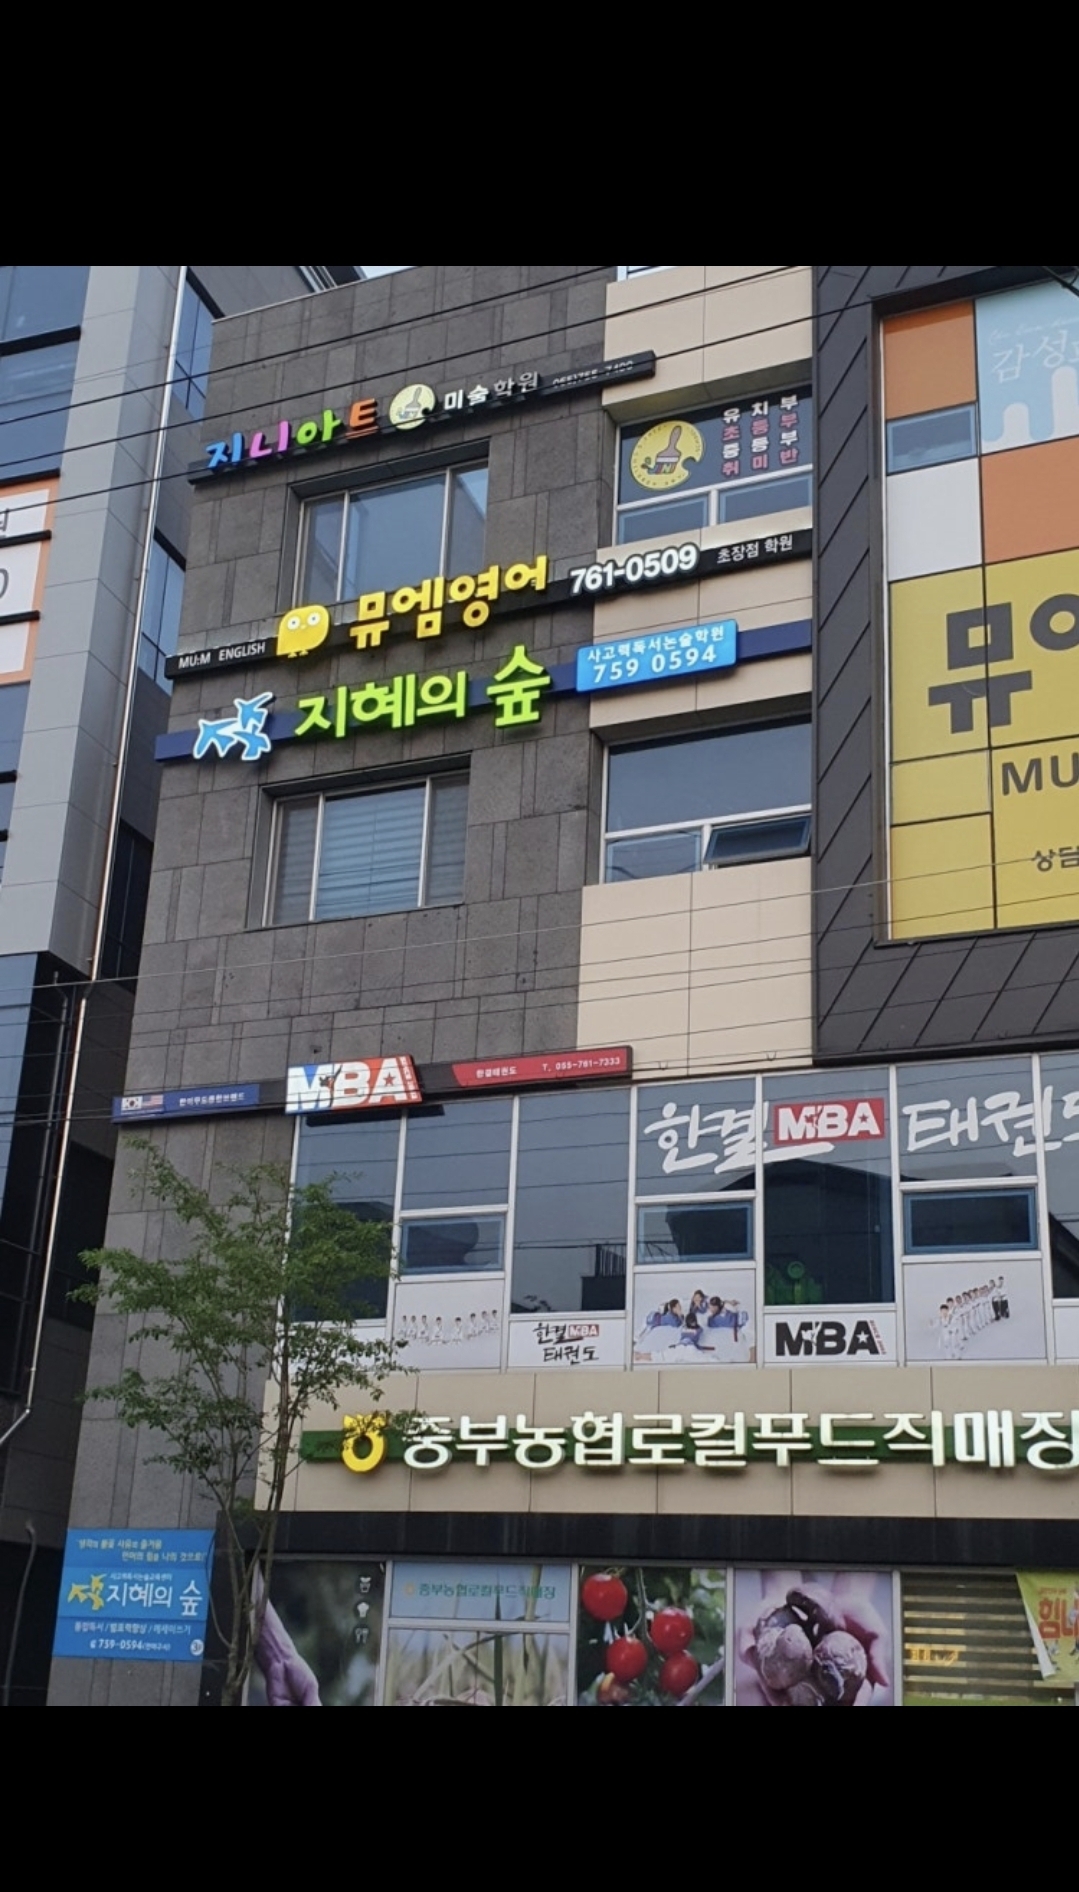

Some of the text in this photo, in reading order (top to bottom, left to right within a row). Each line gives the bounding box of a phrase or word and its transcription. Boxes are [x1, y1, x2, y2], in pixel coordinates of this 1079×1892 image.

[205, 398, 379, 469] 지니아트
[444, 371, 538, 410] 미술학원
[178, 534, 793, 669] MU:M ENGLISH 뮤엠영어 761-0509 초장점 학원
[587, 626, 725, 662] 사고력독서논술학원
[593, 644, 717, 683] 759 0594
[294, 645, 551, 738] 지혜의 숲
[285, 1057, 407, 1114] MBA
[643, 1101, 835, 1175] 한결
[778, 1102, 881, 1141] MBA
[533, 1323, 599, 1345] 한결 MBA
[543, 1345, 599, 1365] 태권도
[775, 1320, 880, 1356] MBA
[403, 1411, 1079, 1470] 중부농협로컬푸드직매장
[106, 1579, 203, 1616] 지혜의 숲
